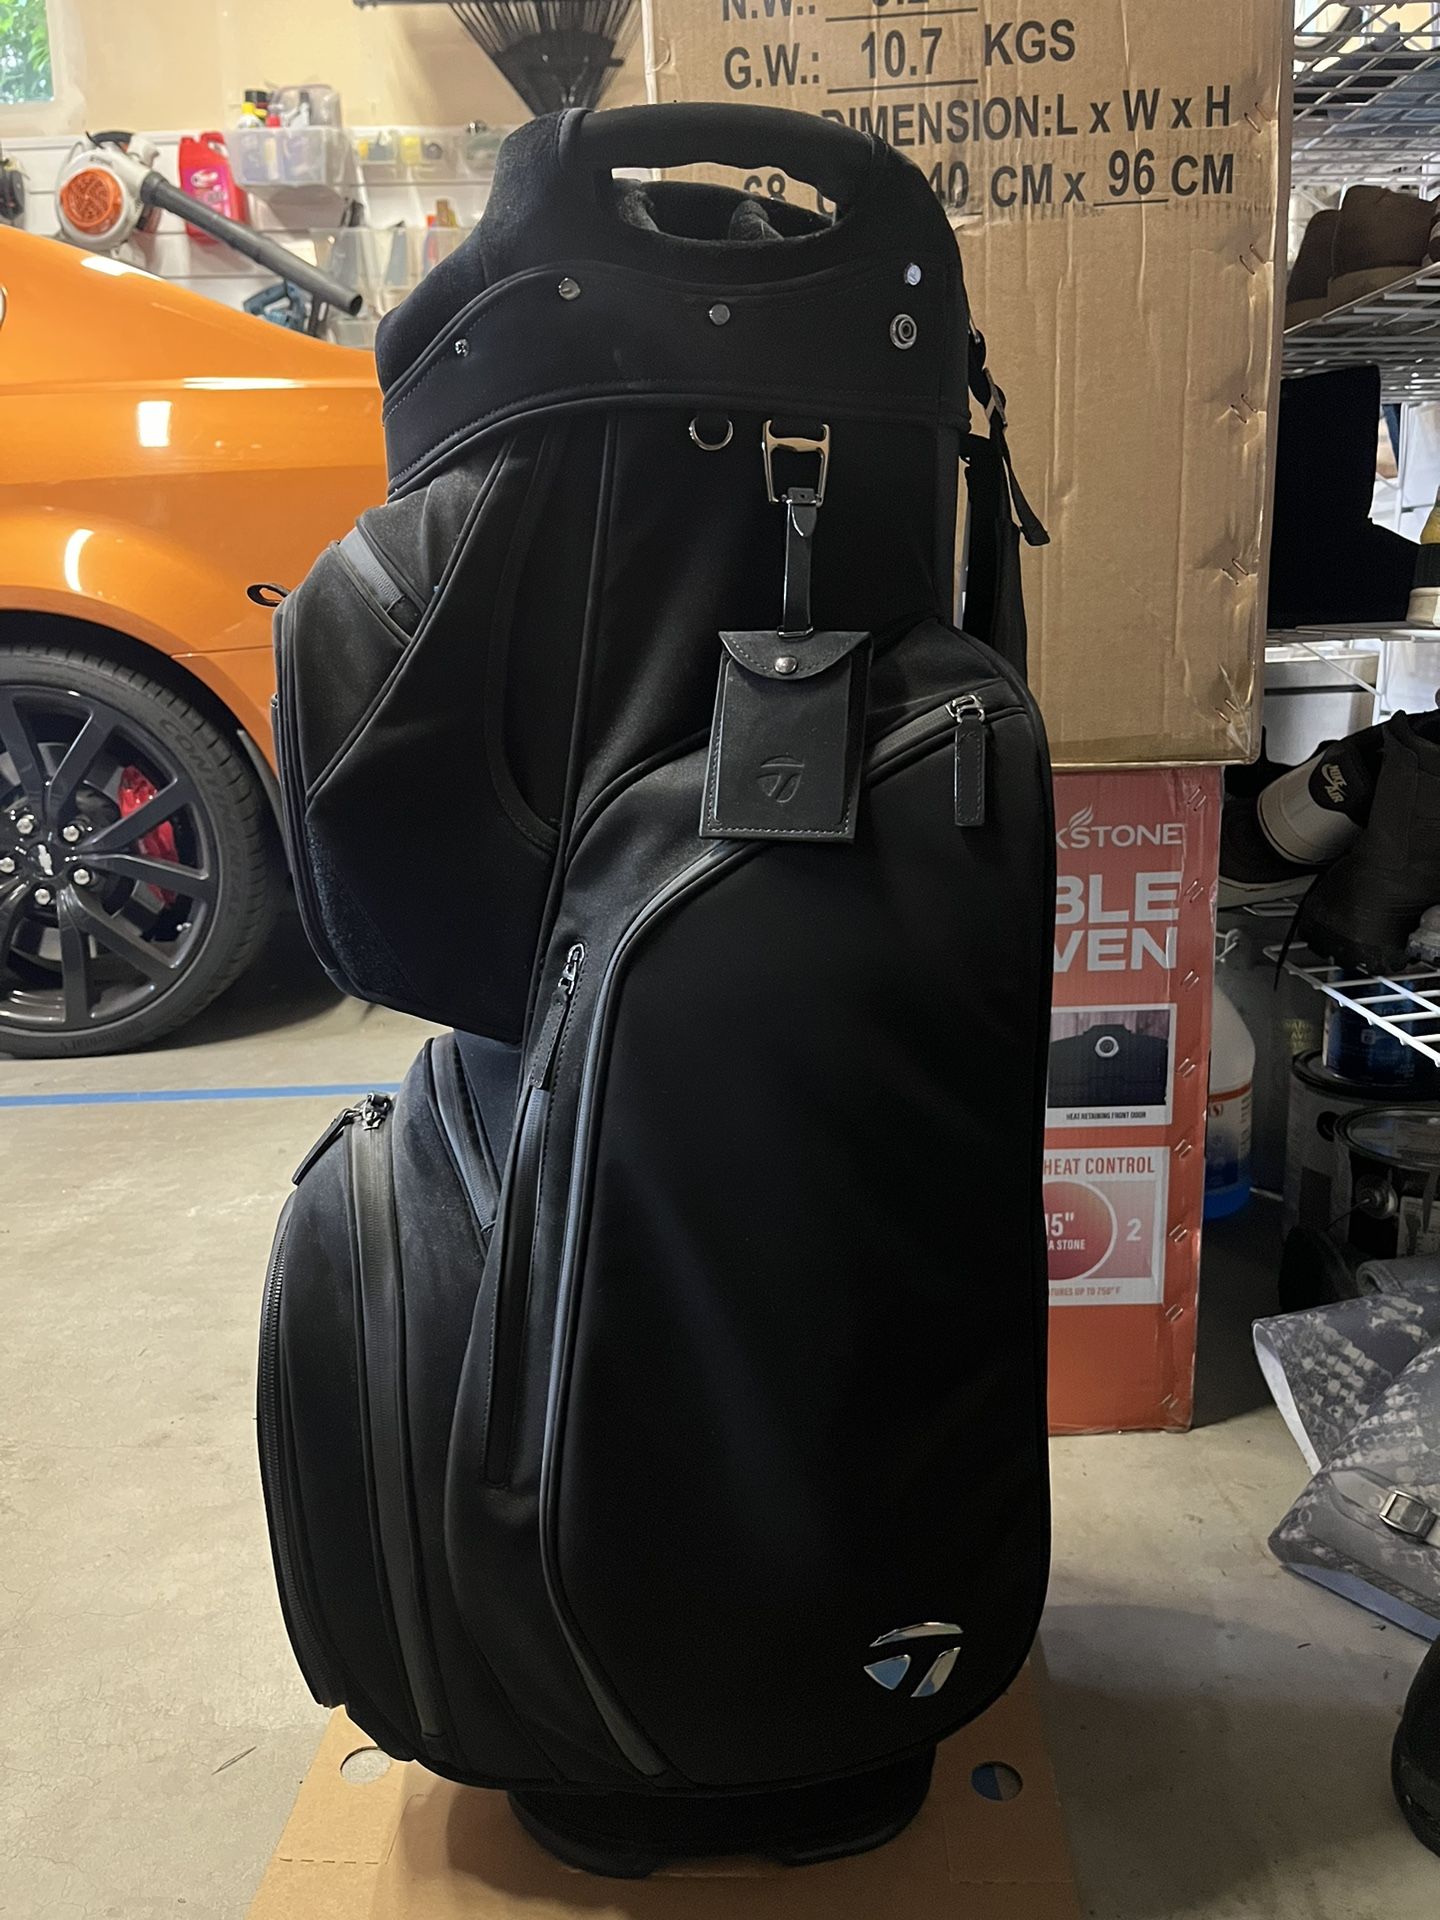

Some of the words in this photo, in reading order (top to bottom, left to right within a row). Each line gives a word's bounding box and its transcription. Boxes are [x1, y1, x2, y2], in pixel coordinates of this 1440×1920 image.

[724, 42, 819, 90] G.W.:
[861, 27, 943, 79] 10.7
[984, 19, 1076, 67] KGS
[1089, 102, 1111, 134] x
[1122, 88, 1160, 132] W
[1171, 97, 1192, 130] x
[1206, 85, 1231, 127] H
[991, 163, 1053, 207] CM
[1063, 172, 1087, 204] x
[1109, 148, 1156, 197] 96
[1171, 154, 1234, 197] CM
[1055, 871, 1182, 925] BLE
[1111, 1111, 1129, 1119] FRONT
[1130, 1111, 1147, 1119] DOOR
[1044, 1158, 1080, 1175] HEAT
[1086, 1156, 1155, 1174] CONTROL
[1056, 1239, 1086, 1251] STONE
[1126, 1218, 1142, 1241] 2
